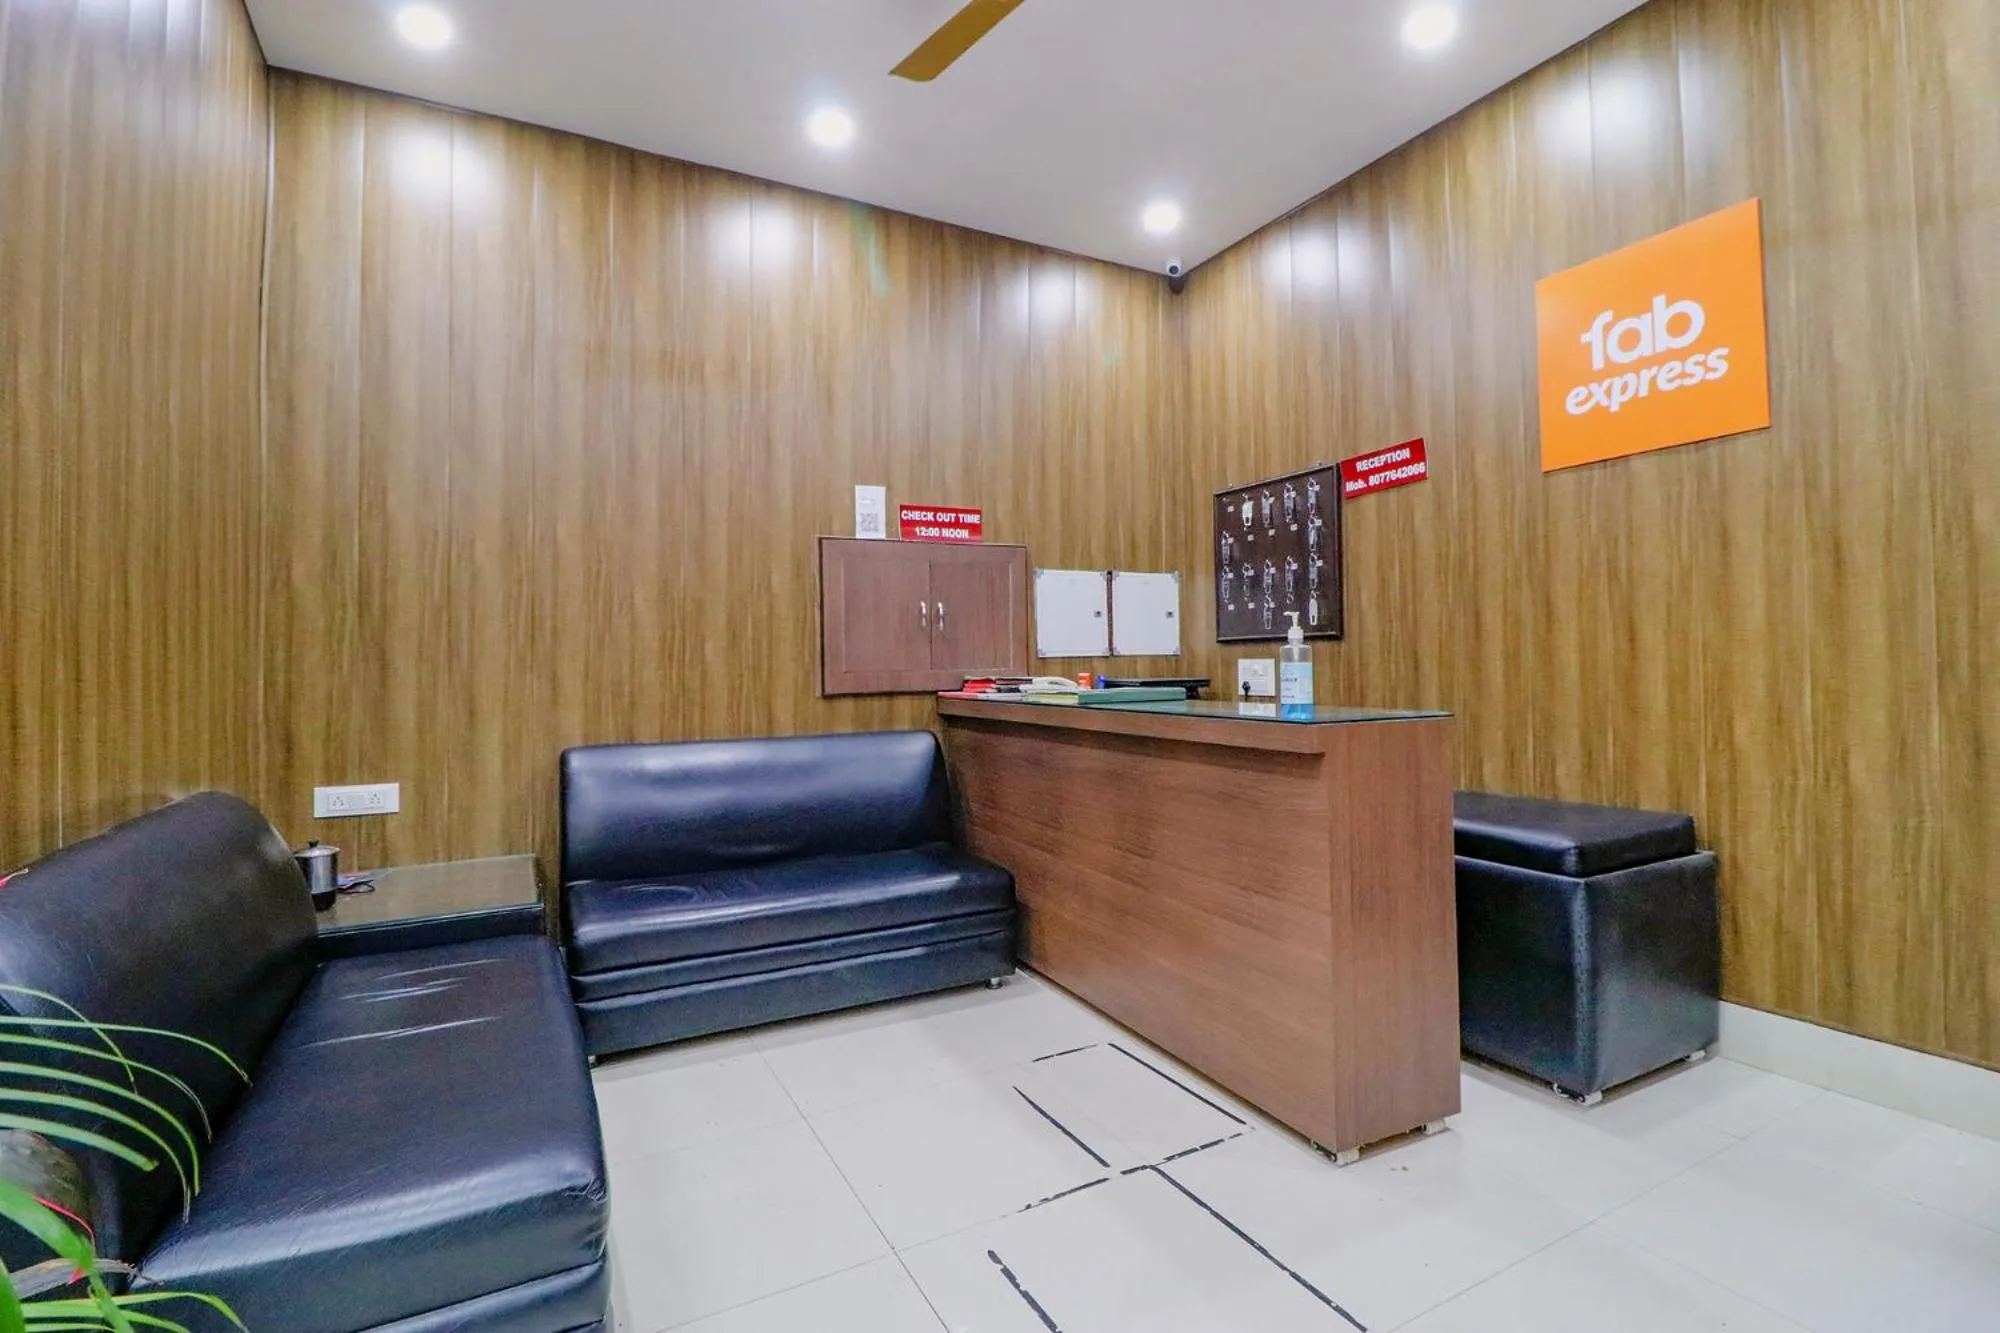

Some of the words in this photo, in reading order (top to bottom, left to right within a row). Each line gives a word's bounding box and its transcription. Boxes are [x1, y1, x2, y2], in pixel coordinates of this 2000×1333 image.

[1580, 294, 1705, 371] fab
[1565, 347, 1729, 415] express
[1355, 448, 1410, 472] RECEPTION
[1346, 479, 1367, 492] Mob.
[901, 510, 934, 522] CHECK
[936, 512, 956, 523] OUT
[958, 514, 980, 523] TIME
[915, 526, 940, 537] 12:00
[942, 528, 969, 538] NOON
